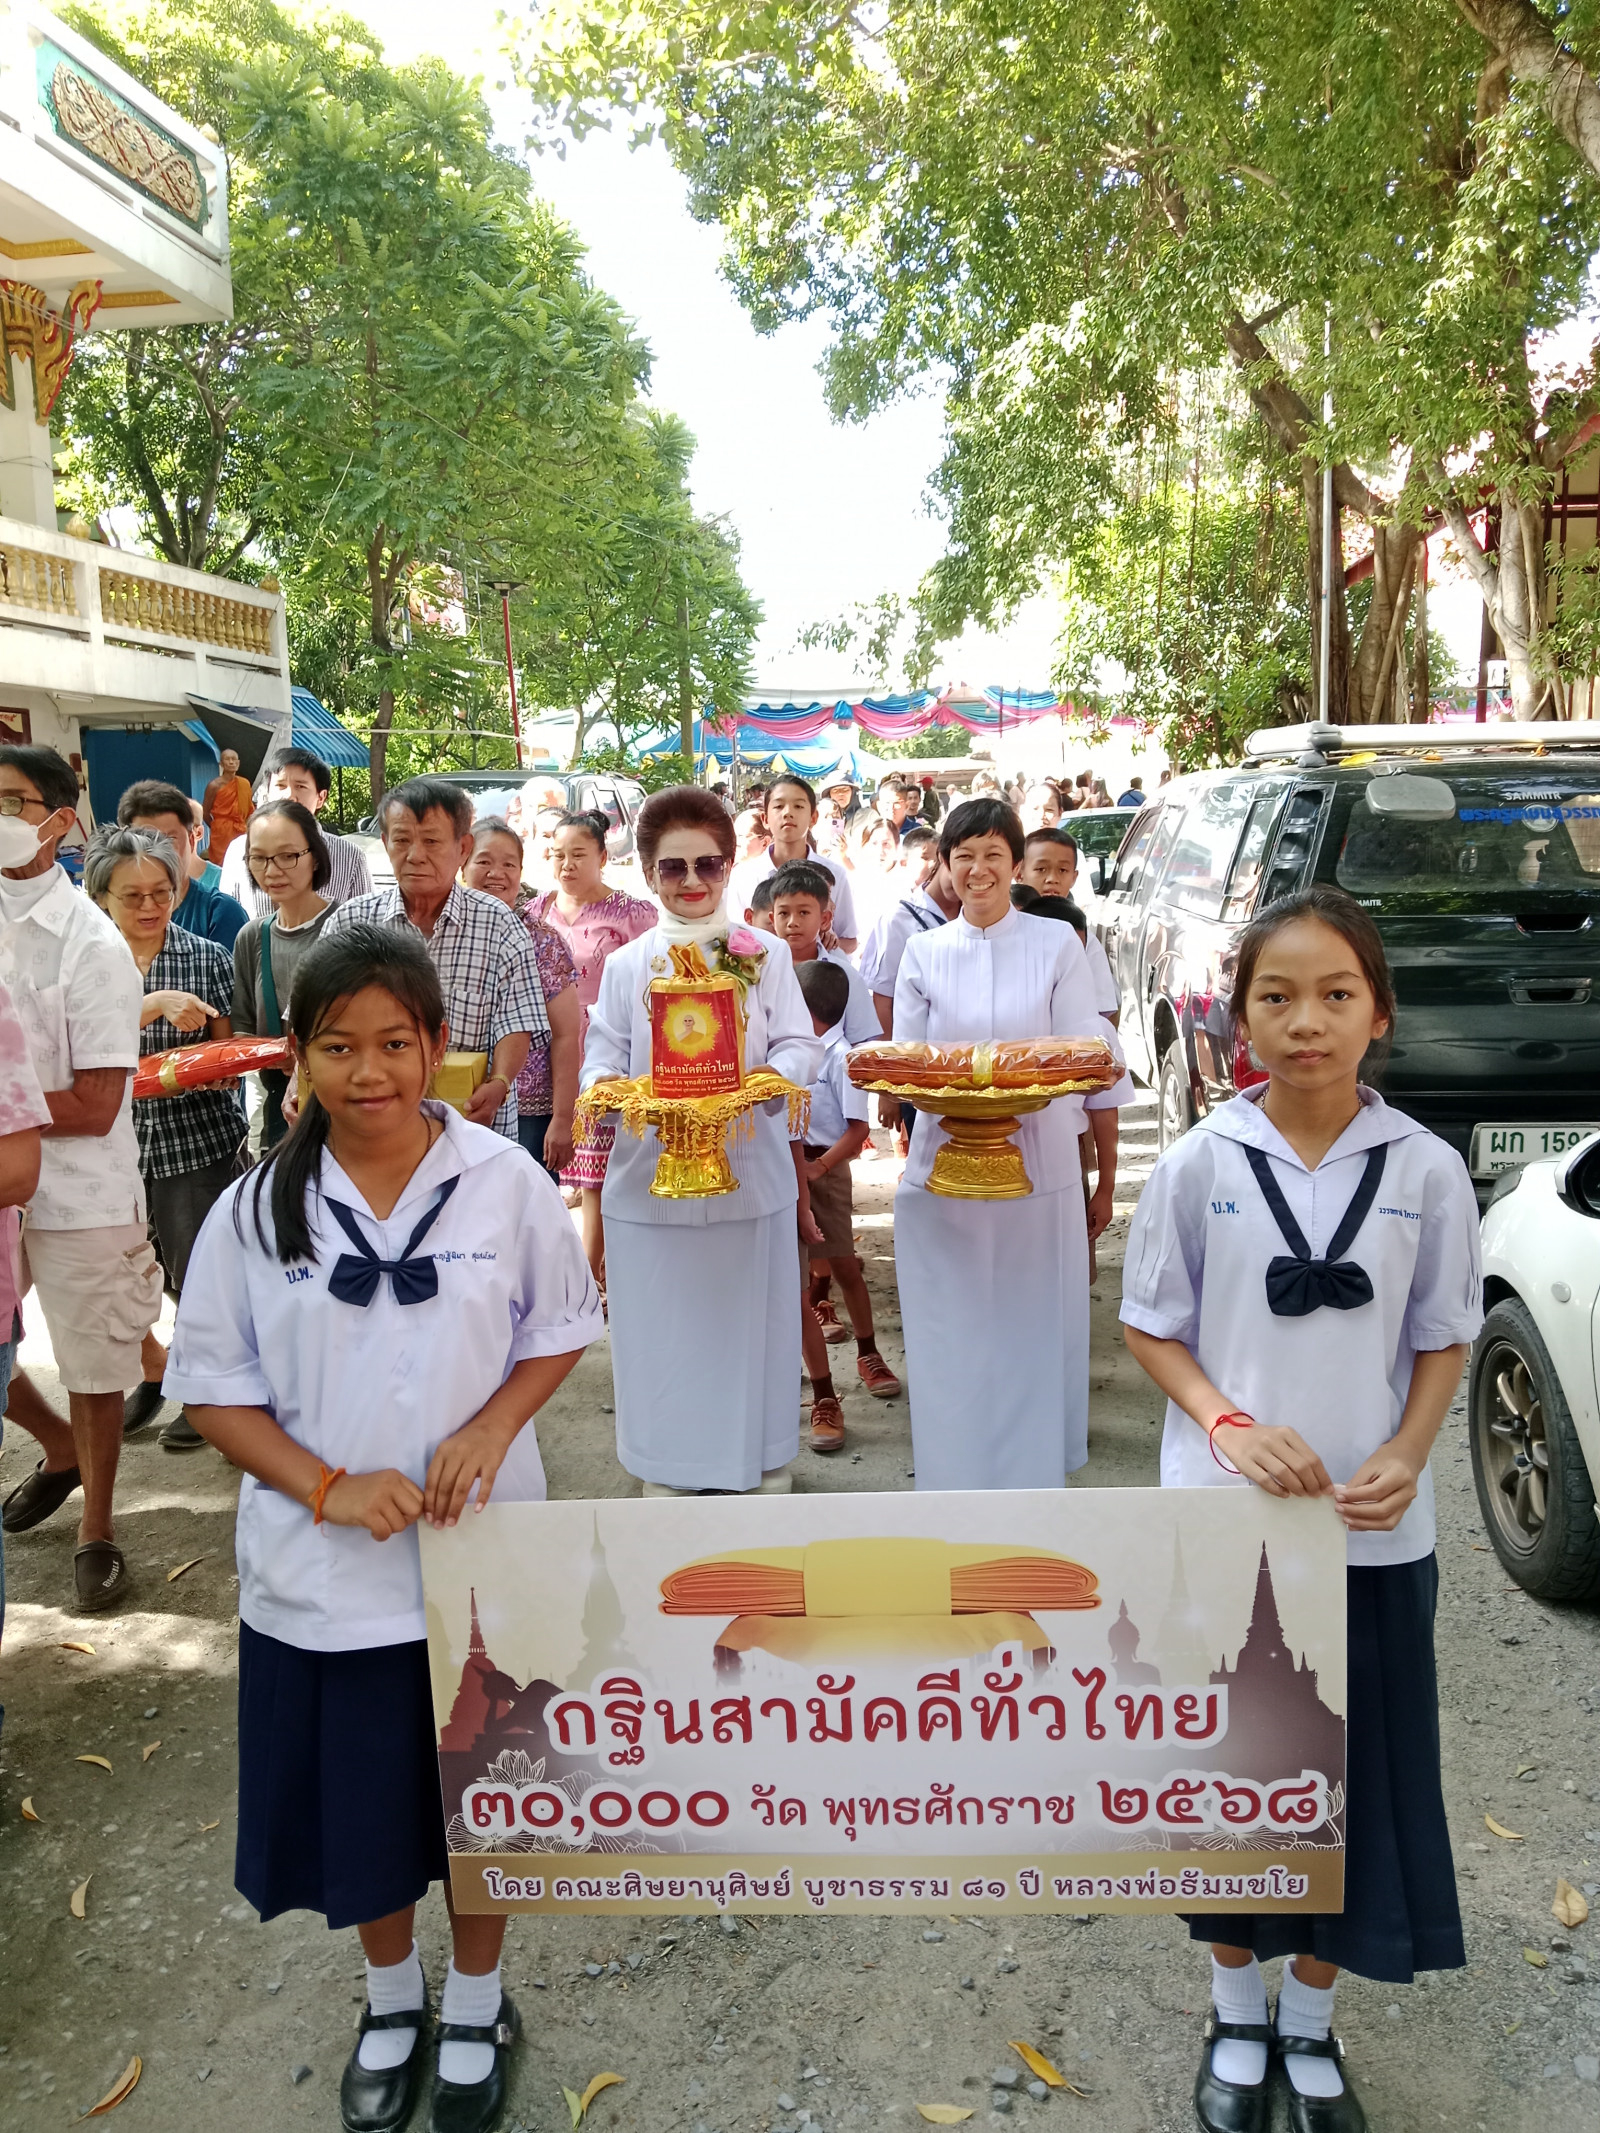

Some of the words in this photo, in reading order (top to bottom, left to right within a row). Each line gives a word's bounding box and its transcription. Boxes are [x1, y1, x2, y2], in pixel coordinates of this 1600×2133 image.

[1506, 791, 1561, 801] SAMMITR
[655, 1060, 734, 1075] กฐินสามัคคีทั่วไทย
[1491, 1131, 1524, 1153] ผก
[1211, 1201, 1240, 1214] บ.พ.
[285, 1266, 314, 1284] บ.พ.
[553, 1651, 1218, 1764] กฐินสามัคคีทั่วไทย
[471, 1790, 730, 1837] ๓๐,๐๐๐
[750, 1783, 807, 1826] วัด
[822, 1782, 1076, 1842] พุทธศักราช
[1097, 1777, 1319, 1825] ๒๕๖๘
[486, 1870, 542, 1897] โดย
[555, 1869, 791, 1906] คณะศิษยานุศิษย์
[804, 1879, 948, 1906] บูชาธรรม
[963, 1880, 1006, 1897] ๘๑
[1019, 1870, 1040, 1896] ปี
[1054, 1868, 1305, 1897] หลวงพ่อธัมมชโย
